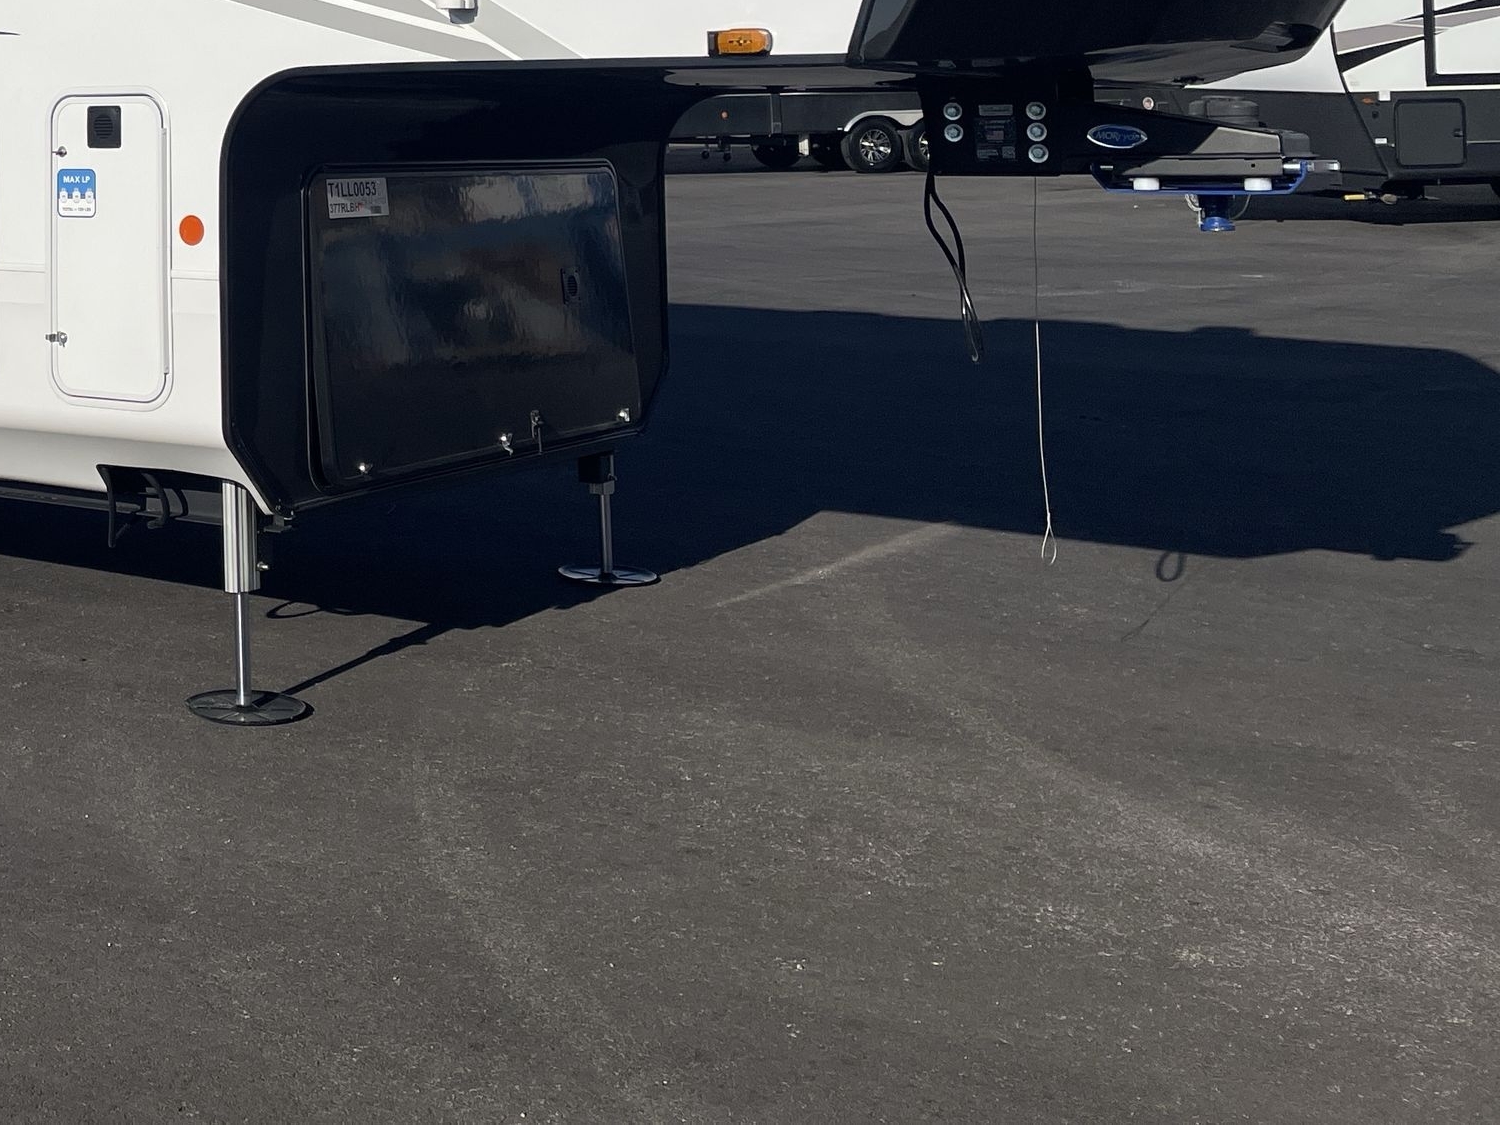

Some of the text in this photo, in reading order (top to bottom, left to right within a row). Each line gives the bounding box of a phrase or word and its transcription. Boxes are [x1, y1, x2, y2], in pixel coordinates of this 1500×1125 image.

[63, 175, 91, 183] MAX LP
[328, 181, 377, 198] T1LL0053
